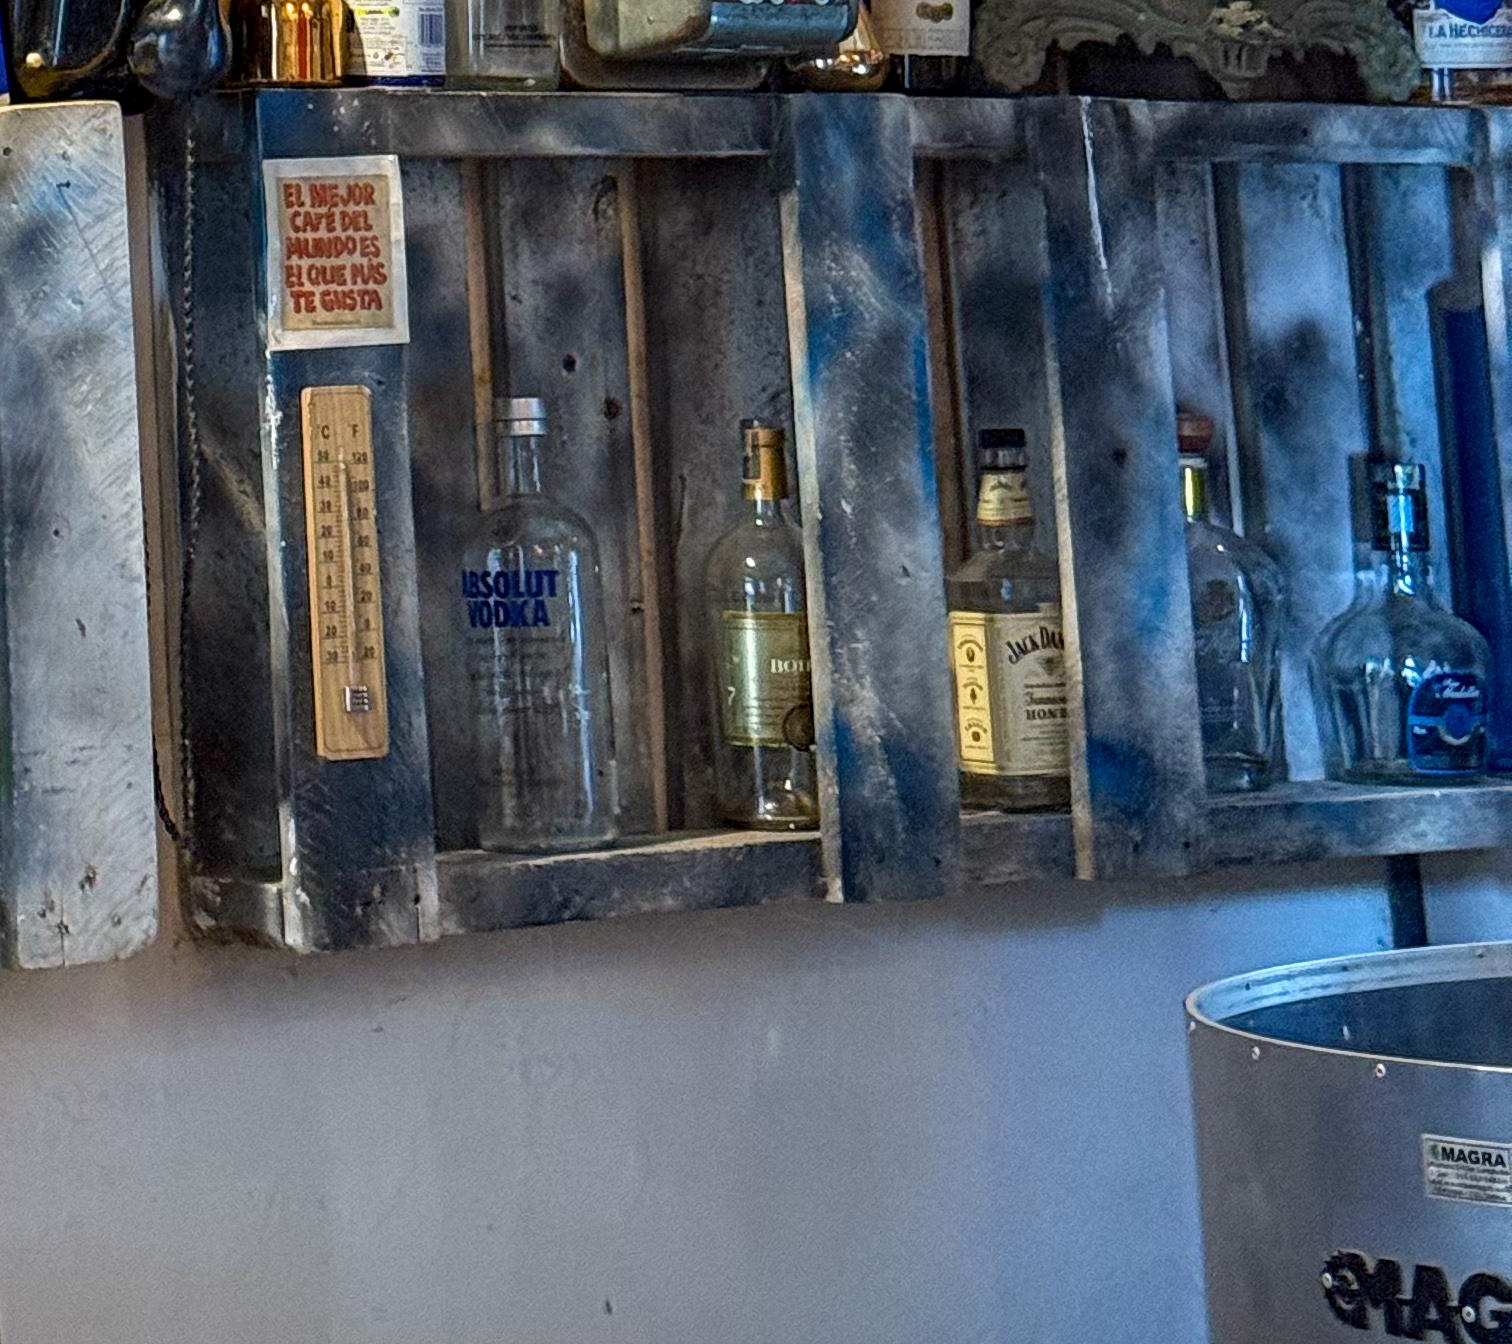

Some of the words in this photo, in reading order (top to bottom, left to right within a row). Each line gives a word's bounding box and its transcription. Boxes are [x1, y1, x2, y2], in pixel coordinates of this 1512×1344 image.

[283, 183, 305, 208] EL
[309, 182, 376, 209] MEJOR
[290, 207, 336, 233] CAFÉ
[341, 210, 373, 232] DEL
[285, 235, 357, 261] MUNDO
[359, 235, 381, 258] ES
[307, 263, 347, 286] QUE
[289, 290, 316, 313] TE
[319, 289, 383, 312] GUSTA
[468, 600, 551, 628] VODKA
[1441, 1146, 1507, 1168] MAGRA
